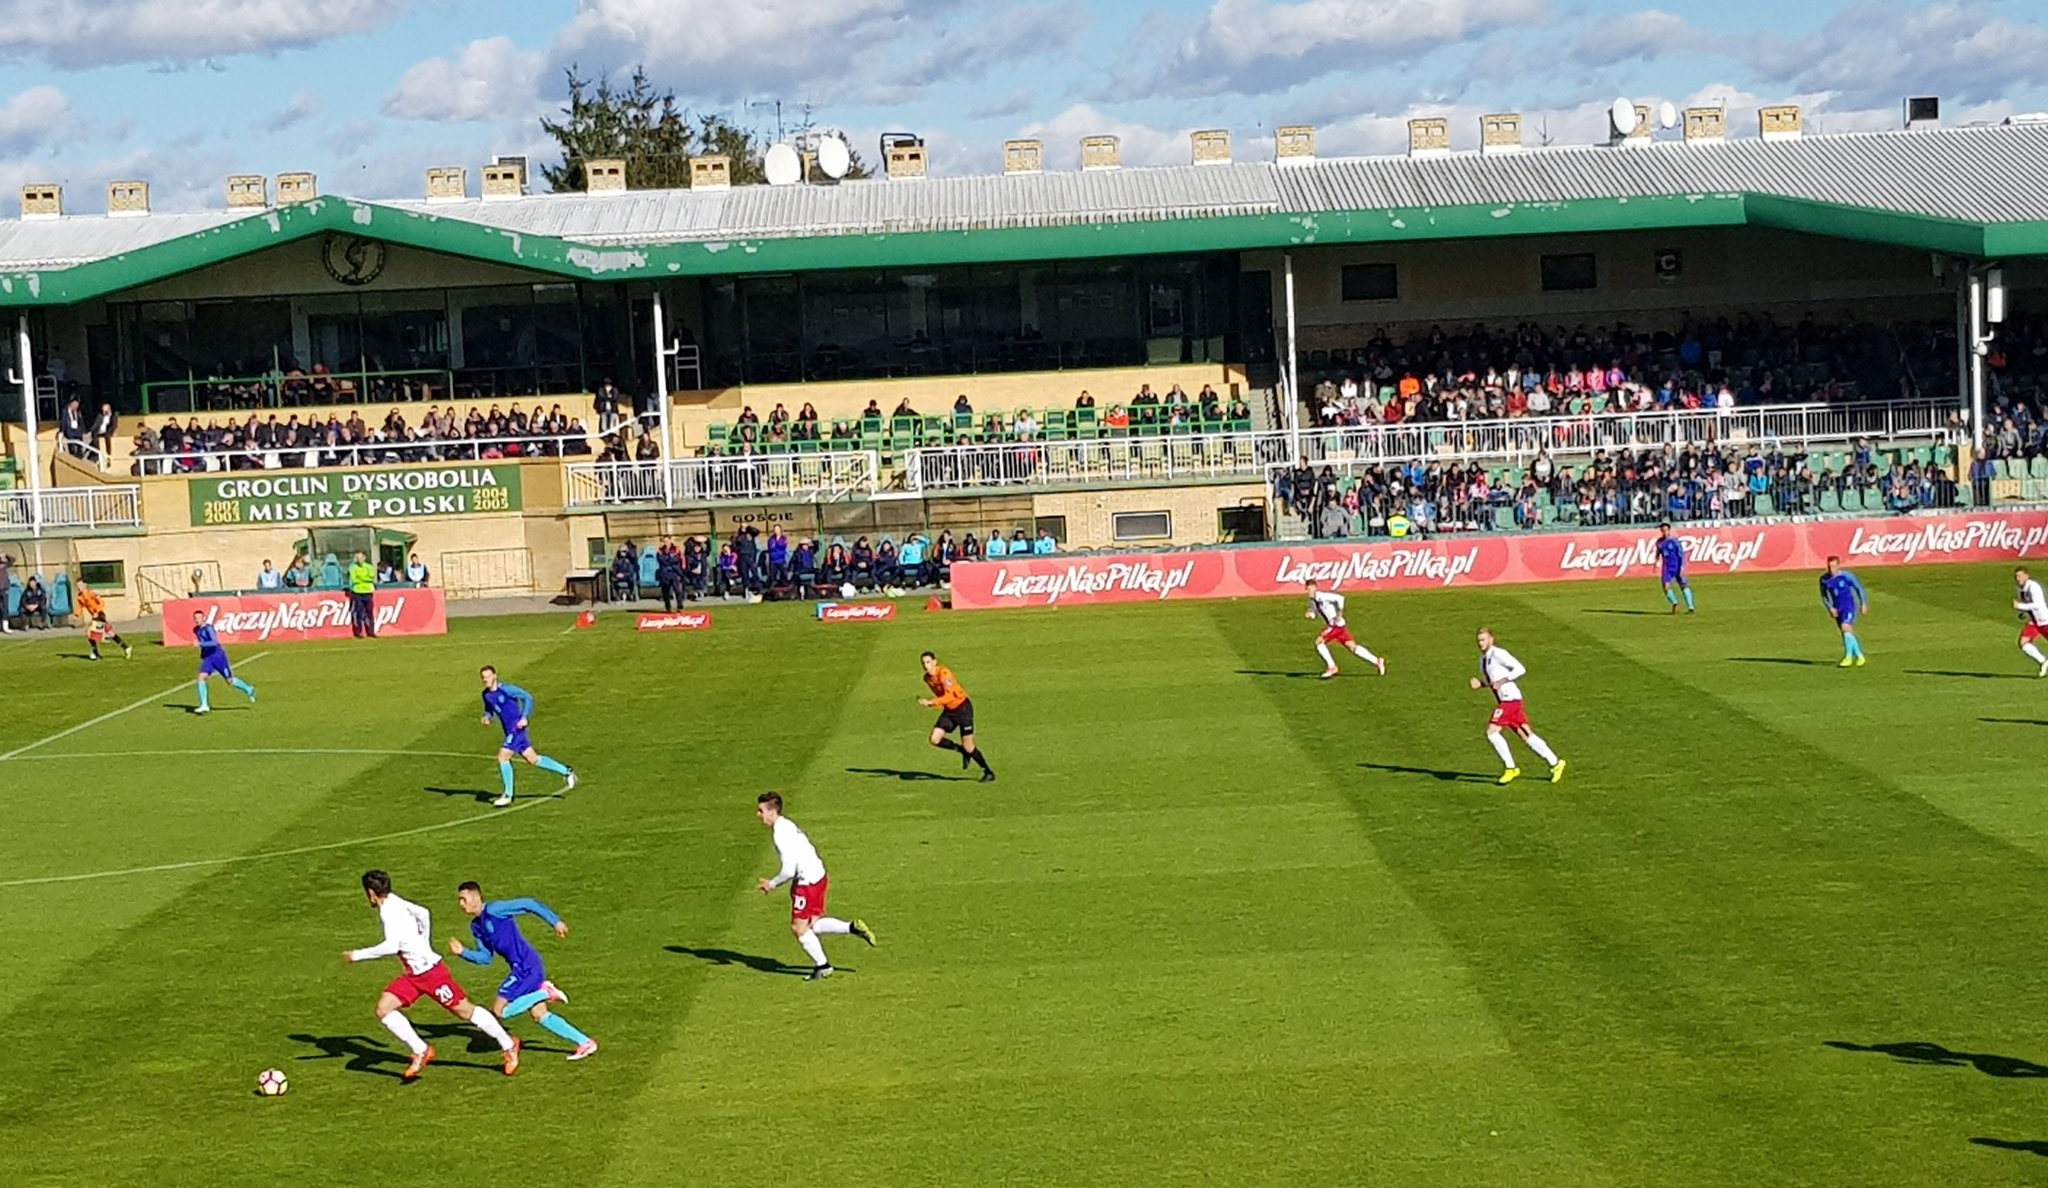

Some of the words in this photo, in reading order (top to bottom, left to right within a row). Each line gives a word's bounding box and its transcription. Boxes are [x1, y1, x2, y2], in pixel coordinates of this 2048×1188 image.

[218, 477, 329, 499] GROCLIN
[343, 468, 497, 493] DYSKOBOLIA
[473, 487, 508, 499] 2004
[248, 500, 353, 522] MISTRZ
[368, 494, 465, 517] POLSKI
[473, 498, 509, 511] 2005
[435, 984, 454, 1003] 20
